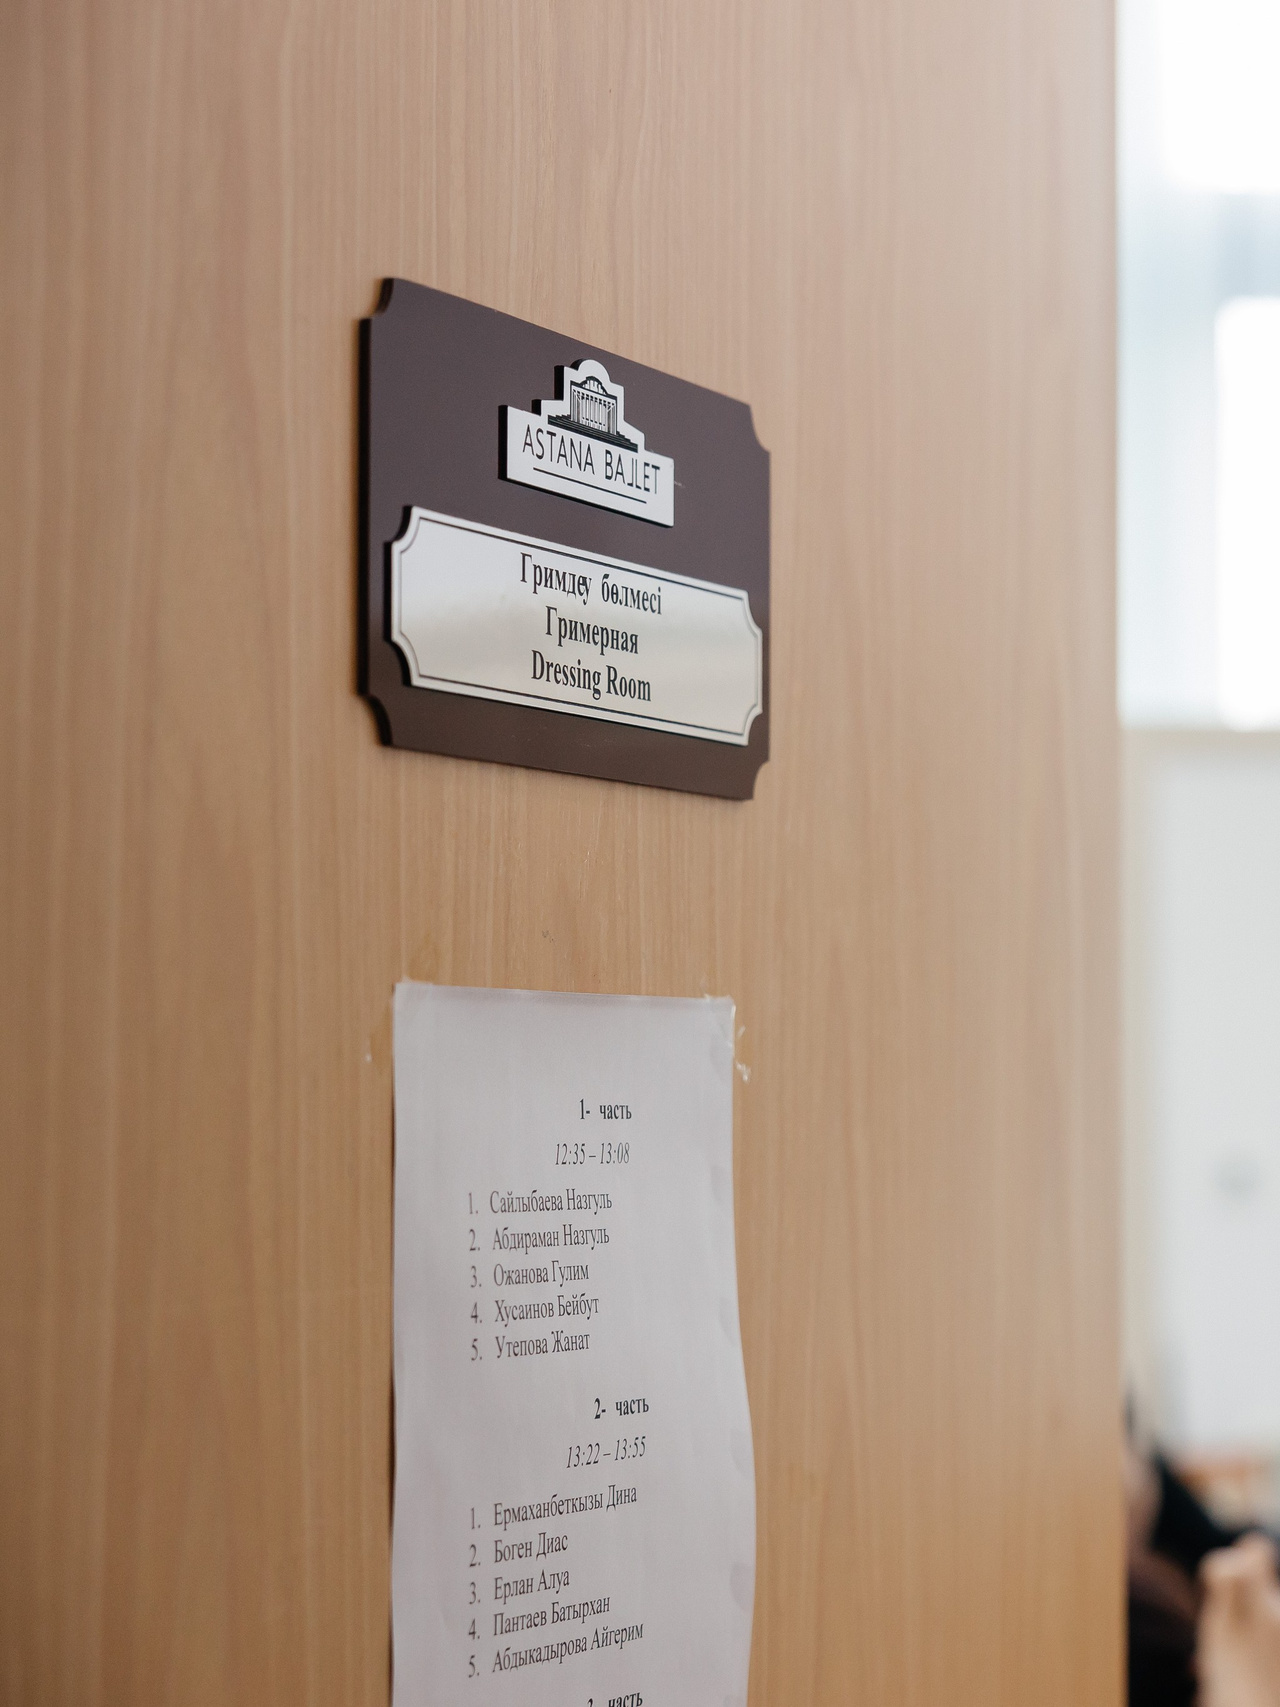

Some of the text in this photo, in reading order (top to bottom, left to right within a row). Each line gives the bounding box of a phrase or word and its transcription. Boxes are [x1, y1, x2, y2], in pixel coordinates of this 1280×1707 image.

[522, 424, 660, 494] ASTANA BALLET
[520, 552, 662, 615] Гримдеу бөлмесі
[545, 605, 639, 656] Гримерная
[531, 649, 651, 702] Dressing Room
[580, 1098, 632, 1120] 1- часть
[555, 1143, 586, 1166] 12:35
[600, 1142, 630, 1165] 13:08
[468, 1188, 613, 1216] 1. Сайлыбаева Назгуль
[469, 1223, 610, 1255] 2. Абдираман Назгуль
[470, 1260, 589, 1288] 3. Ожанова Гулим
[470, 1292, 600, 1328] 4. Хусаинов Бейбут
[471, 1329, 591, 1362] 5. Утепова Жанат
[594, 1397, 650, 1420] 2- часть
[566, 1442, 601, 1469] 13:22
[614, 1435, 647, 1462] 13:55
[471, 1483, 638, 1531] 1. Ермаханбеткызы Дина
[469, 1531, 569, 1568] 2. Боген Диас
[469, 1569, 570, 1605] 3. Ерлан Алуа
[468, 1596, 611, 1640] 4. Пантаев Батырхан
[468, 1623, 645, 1678] 5. Абдыкадырова Айгерим
